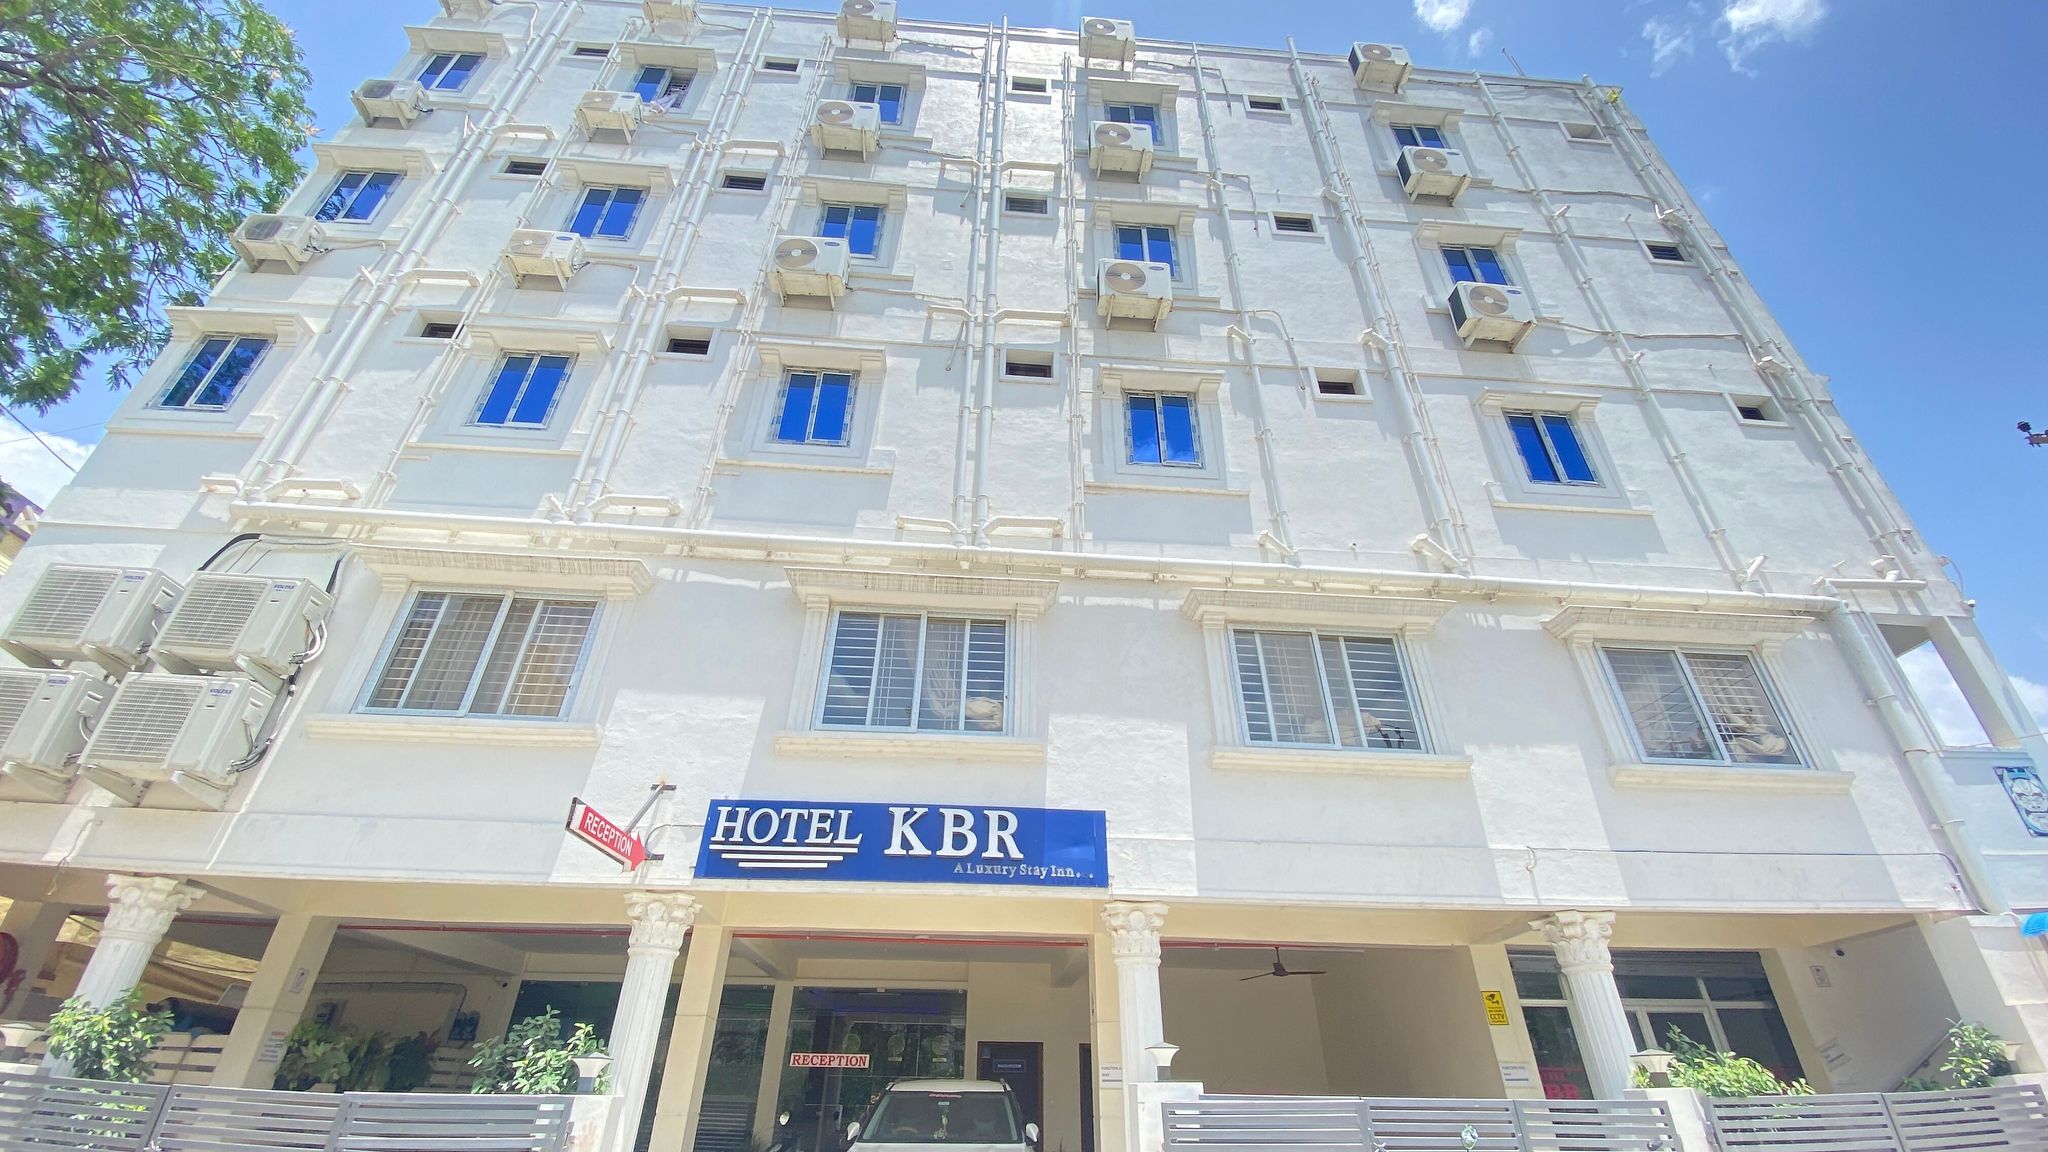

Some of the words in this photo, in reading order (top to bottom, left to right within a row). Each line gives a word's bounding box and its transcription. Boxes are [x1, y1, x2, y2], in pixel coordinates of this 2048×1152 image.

[584, 812, 632, 856] RECEPTION
[711, 806, 863, 844] HOTEL
[884, 807, 1024, 859] KBR
[953, 862, 965, 874] A
[966, 863, 1017, 878] Luxury
[1019, 864, 1048, 879] Stay
[792, 1054, 868, 1067] RECEPTION
